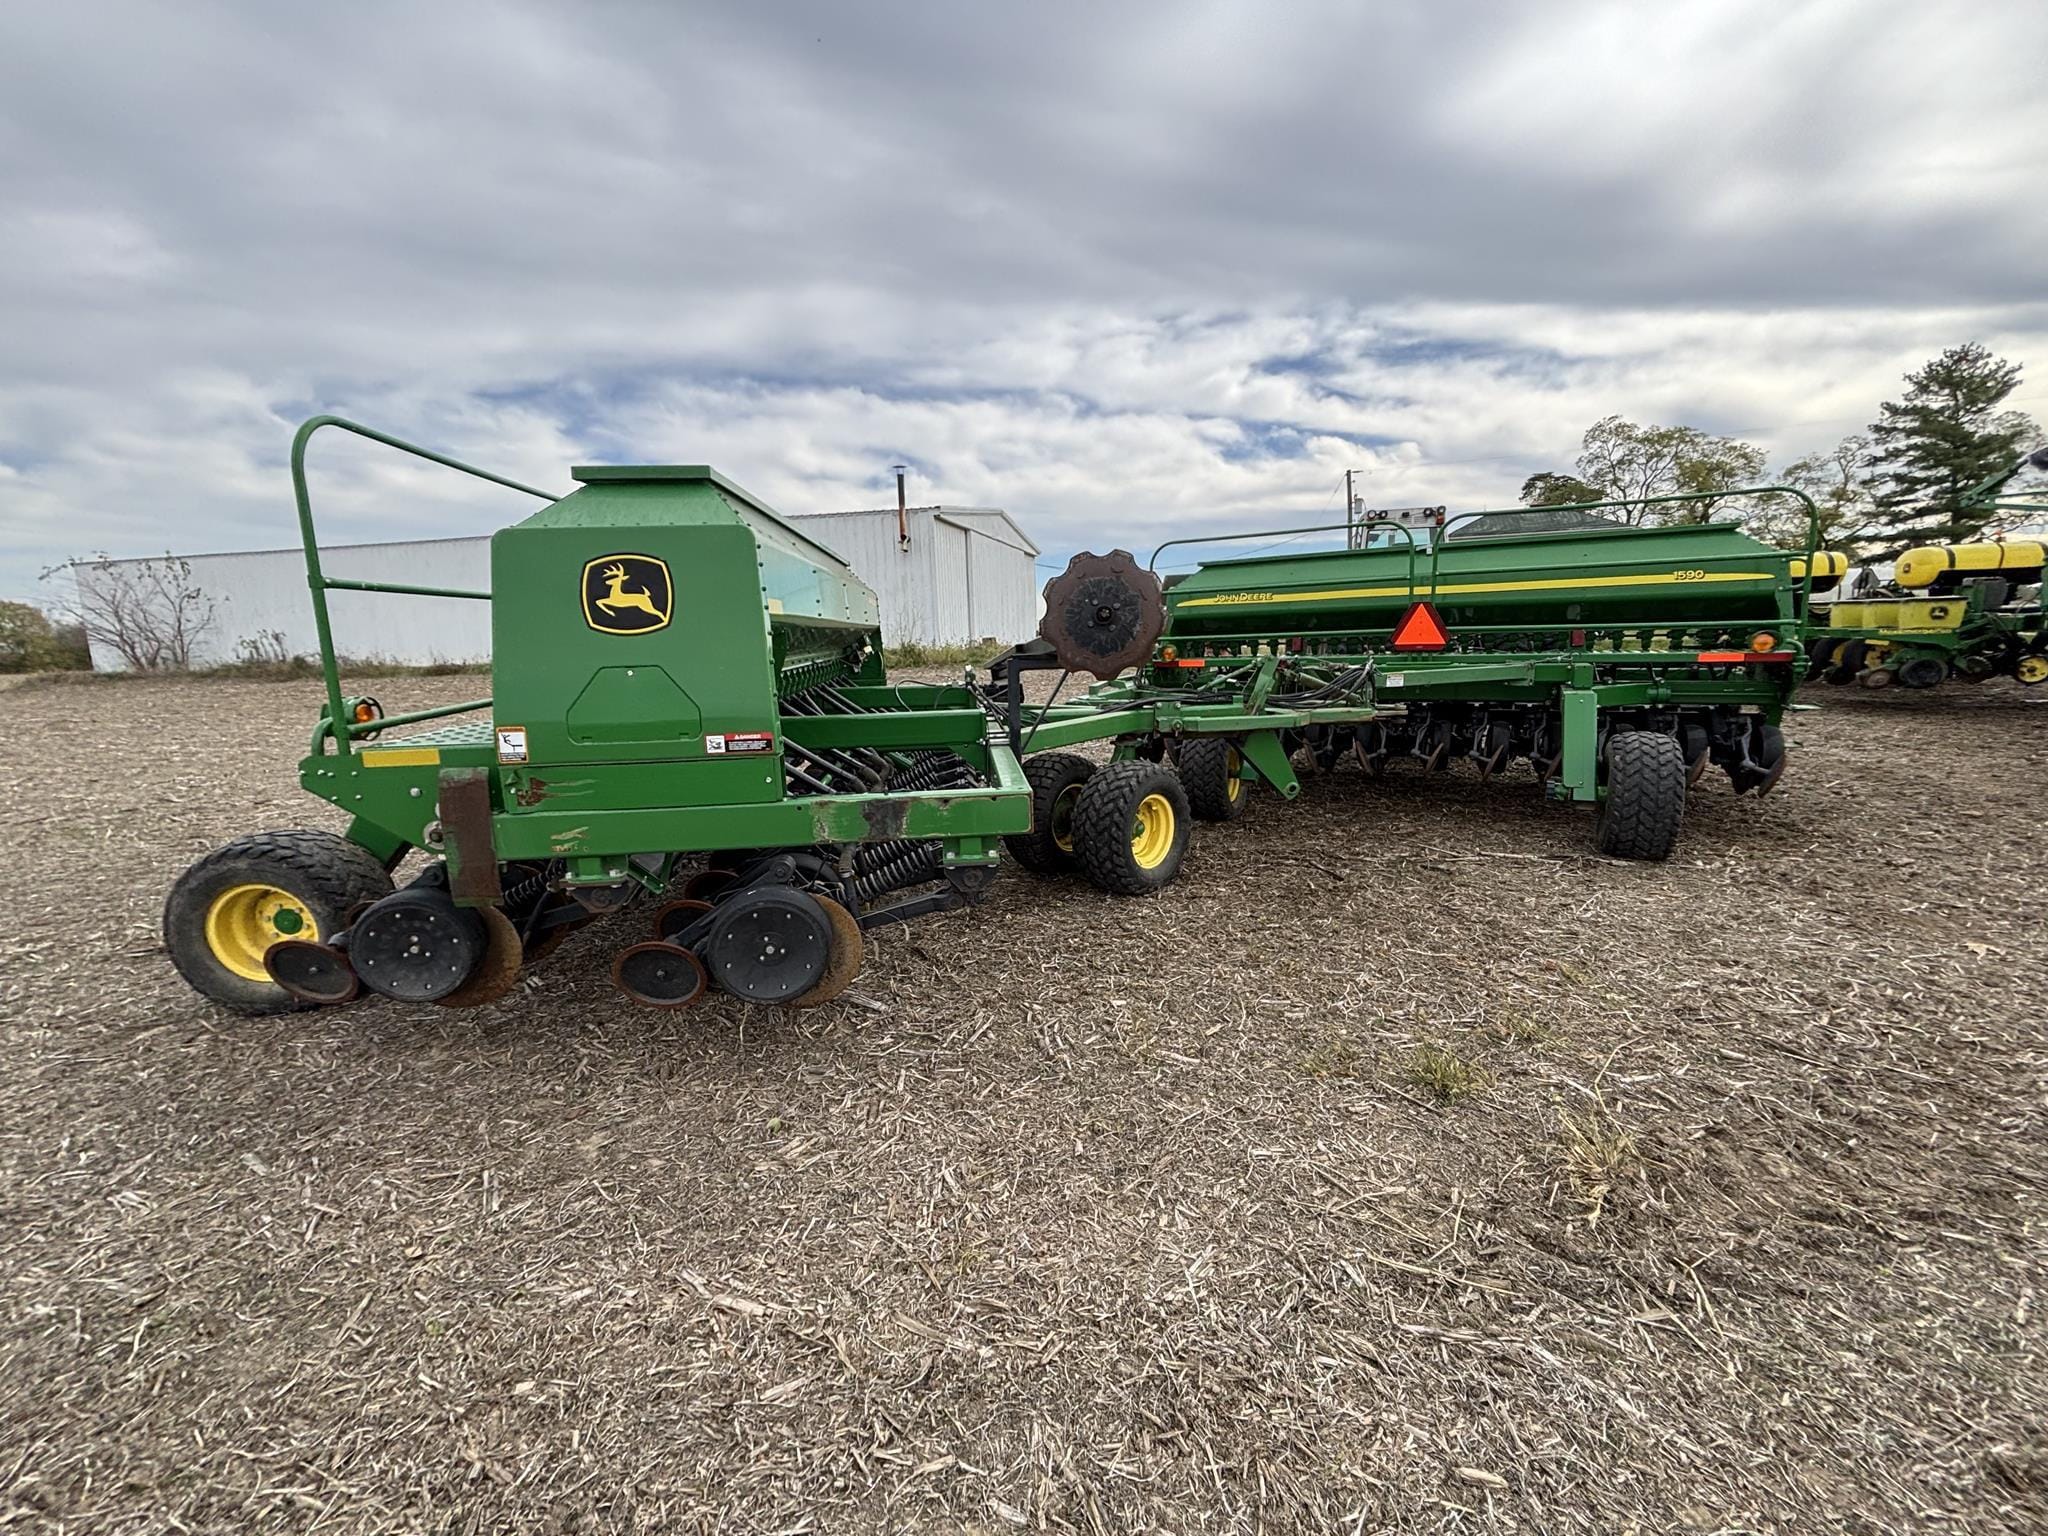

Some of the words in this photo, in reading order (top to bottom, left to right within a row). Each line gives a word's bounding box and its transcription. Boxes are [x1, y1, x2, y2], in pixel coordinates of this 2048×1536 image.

[1673, 569, 1705, 580] 1590
[1214, 593, 1239, 603] JOHN
[1240, 592, 1274, 601] DEERE
